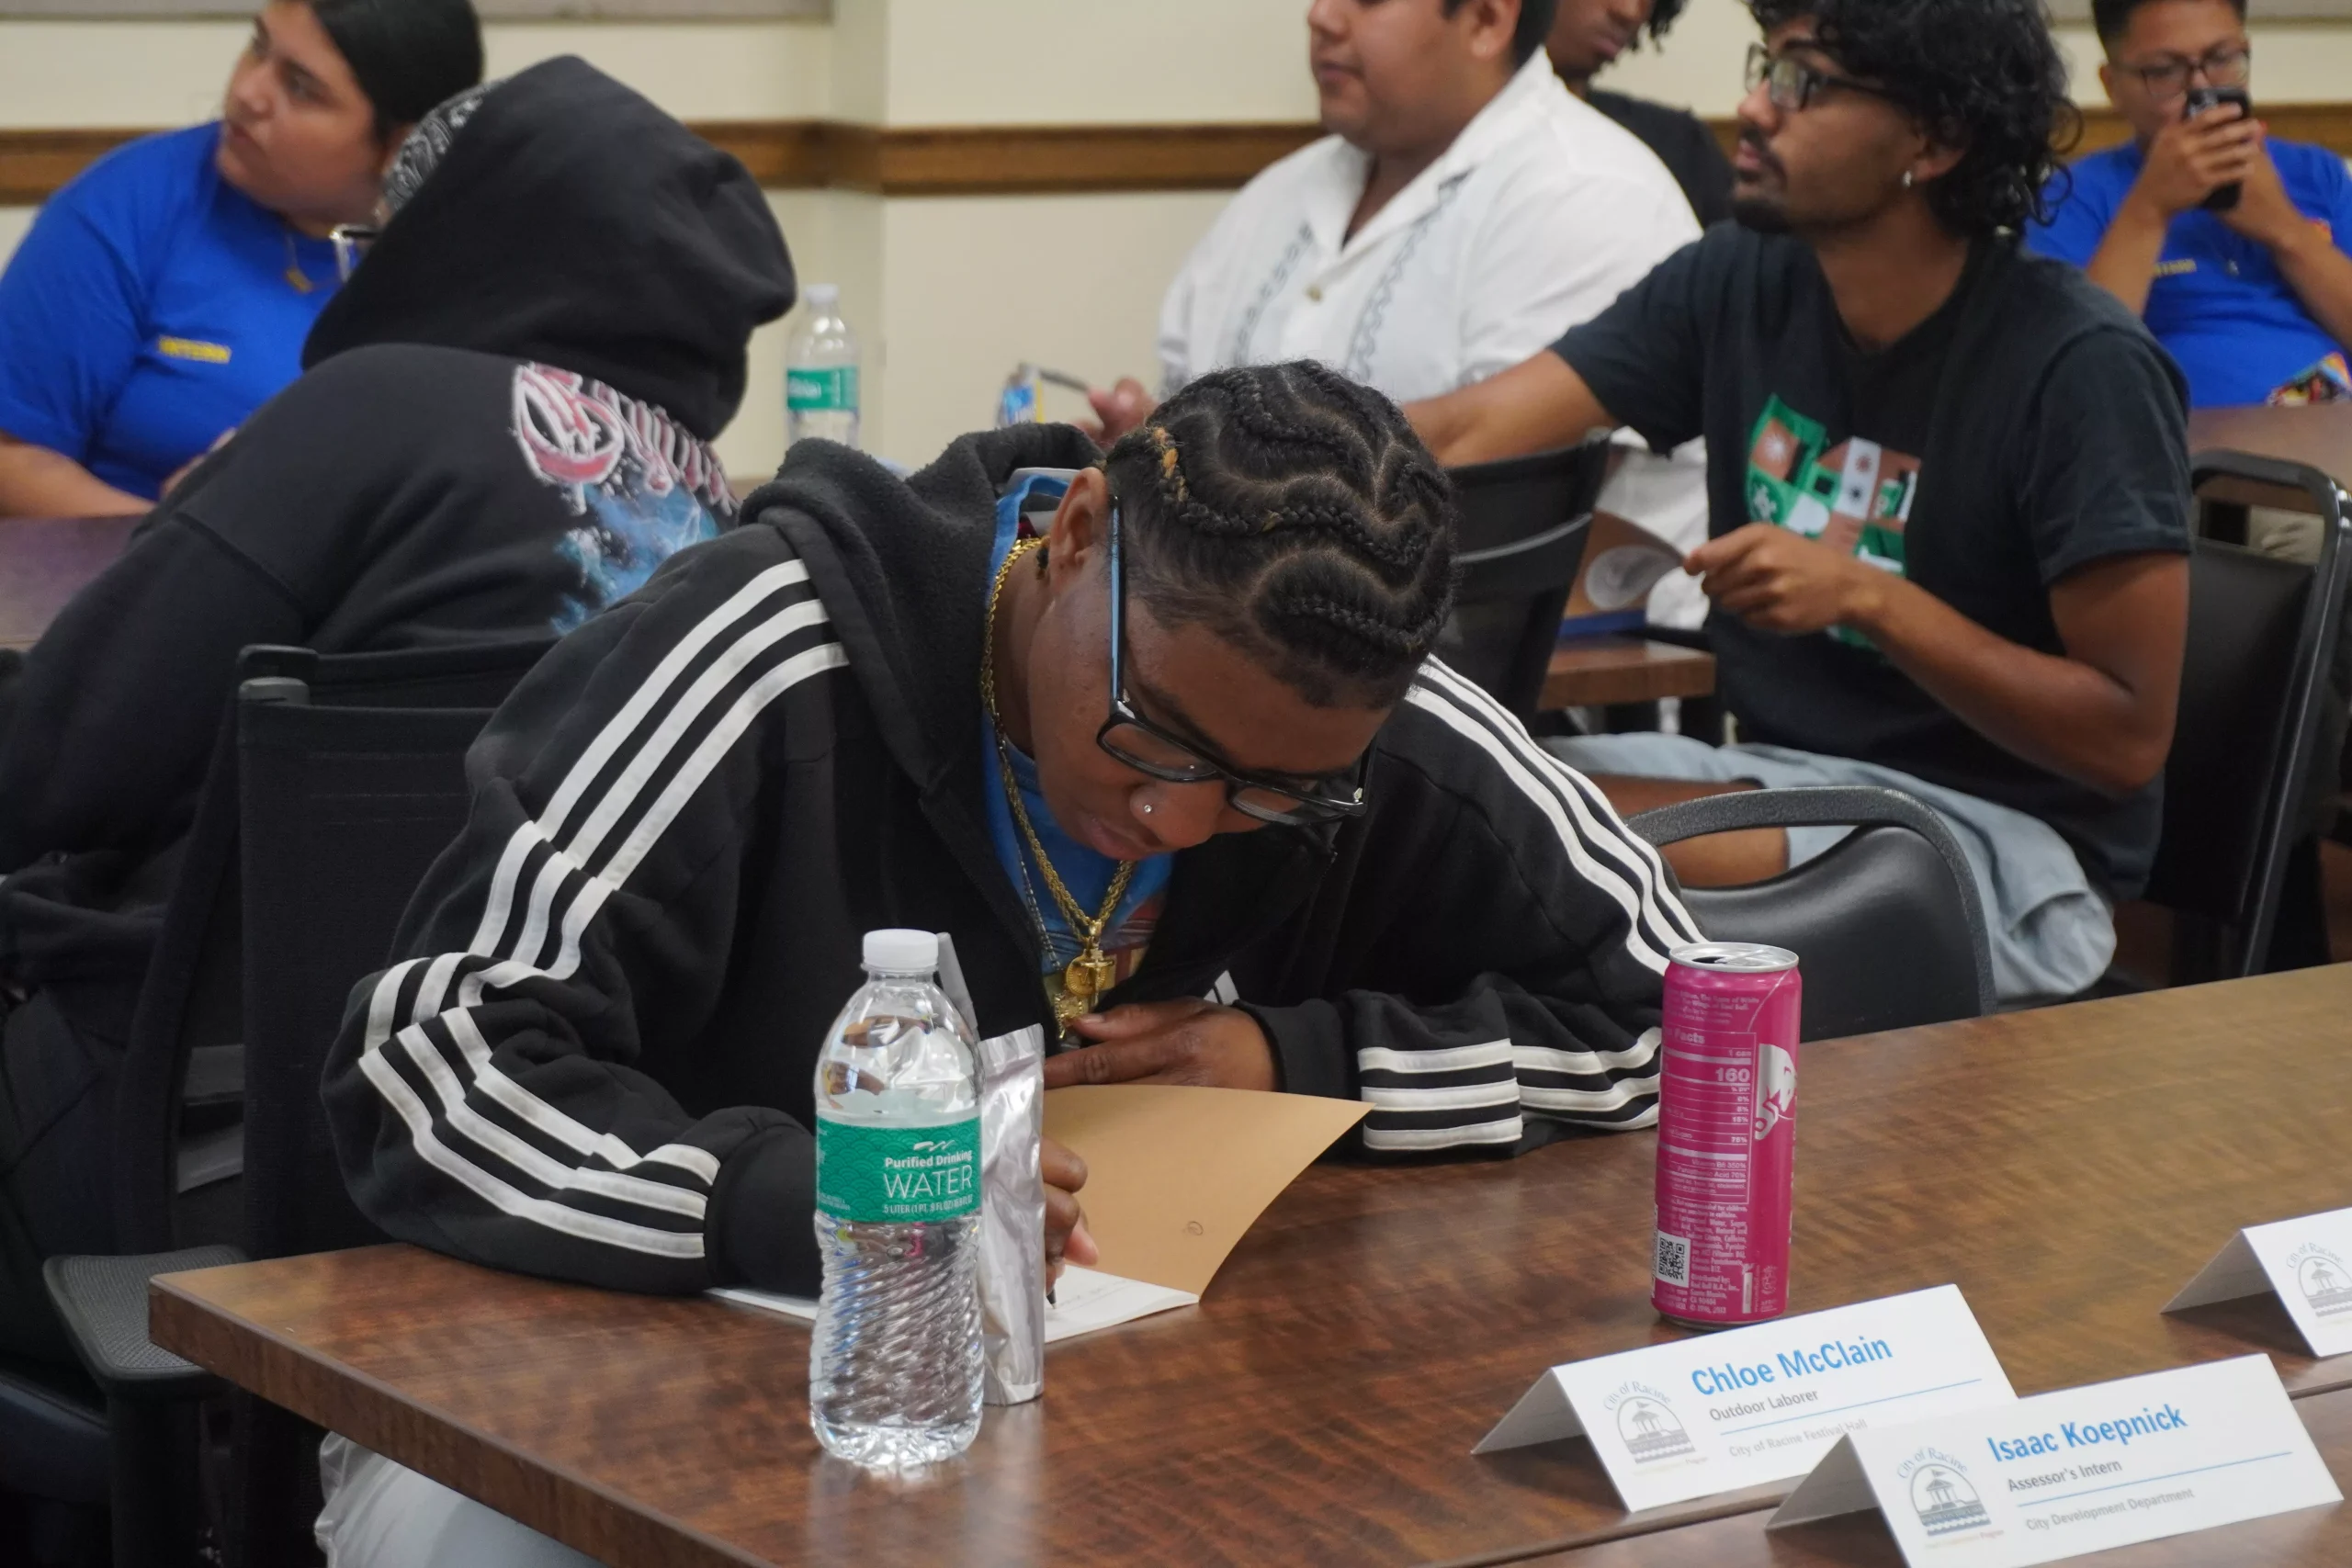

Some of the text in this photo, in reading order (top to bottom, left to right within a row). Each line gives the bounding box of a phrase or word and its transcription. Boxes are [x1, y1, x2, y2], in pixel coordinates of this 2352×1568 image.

[1674, 1028, 1705, 1044] Facts
[1715, 1067, 1750, 1082] 160
[885, 1150, 972, 1168] Purified Drinking
[883, 1165, 972, 1199] WATER
[890, 1204, 910, 1213] LITER
[1691, 1336, 1894, 1395] Chloe McClain
[1602, 1380, 1672, 1411] City of Racine
[1709, 1391, 1819, 1422] Outdoor Laborer
[1729, 1417, 1869, 1459] City of Racine Festival Hall
[1986, 1404, 2188, 1462] Isaac Koepnick
[1896, 1447, 1968, 1479] City of Racine
[2007, 1460, 2123, 1493] Assessor's Intern
[2026, 1487, 2196, 1531] City Development Department
